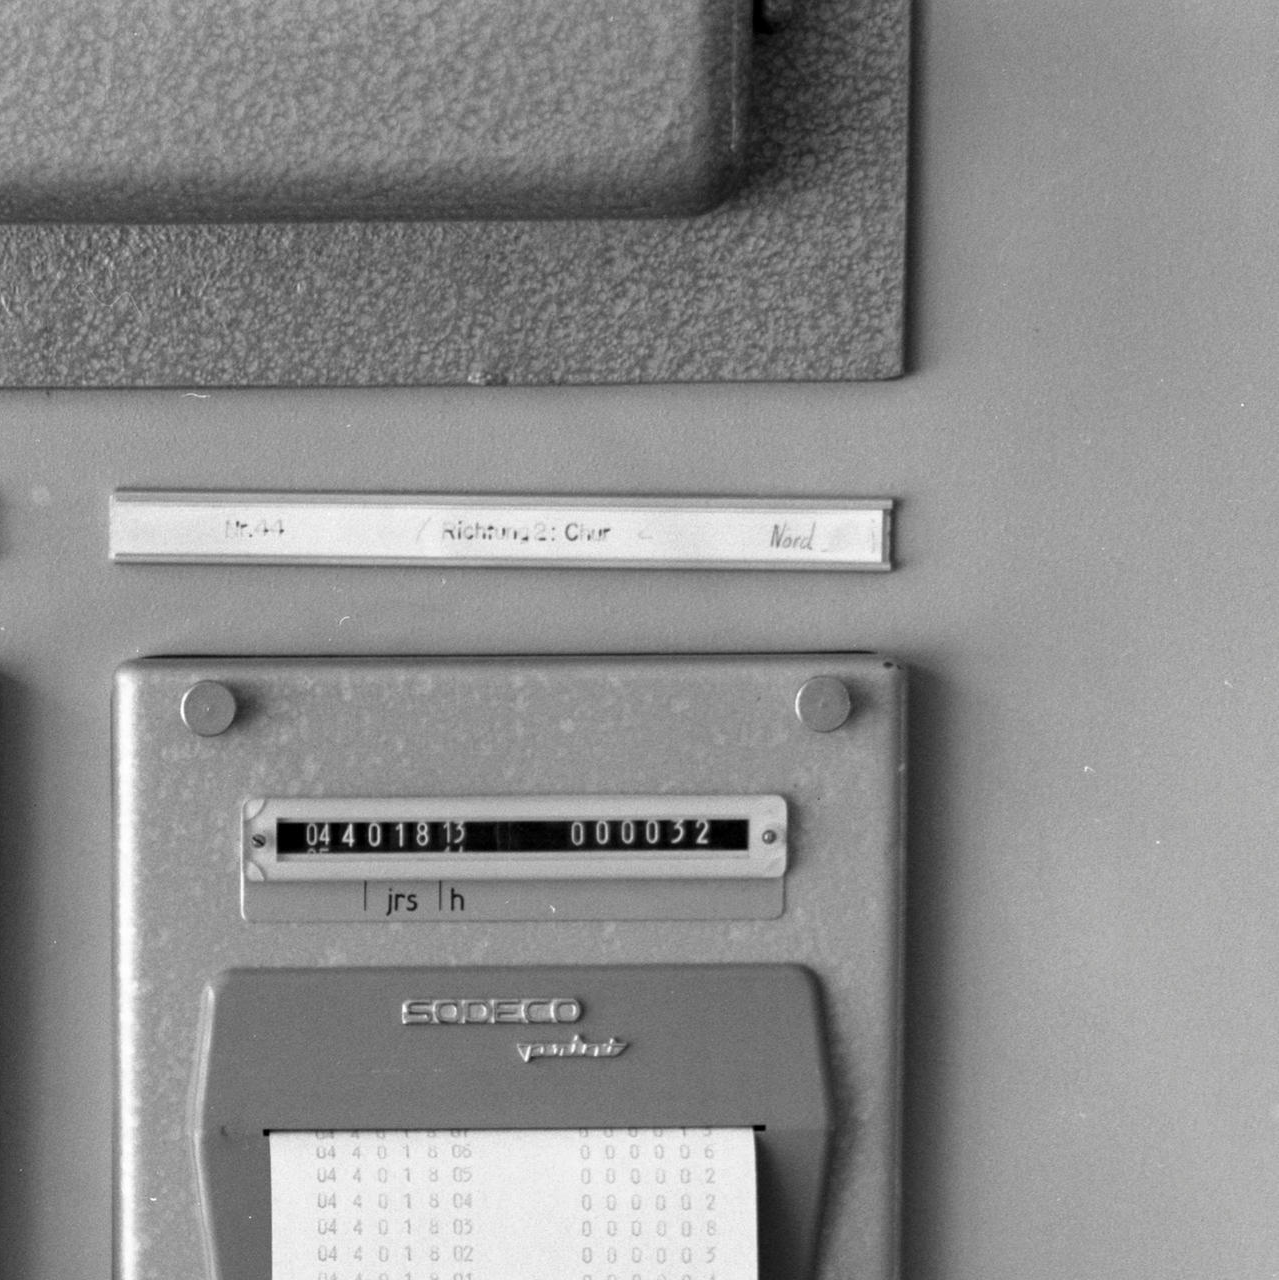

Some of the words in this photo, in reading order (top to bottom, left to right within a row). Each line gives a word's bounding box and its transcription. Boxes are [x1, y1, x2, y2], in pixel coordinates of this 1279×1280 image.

[563, 521, 612, 542] Chur
[769, 519, 817, 551] Nord
[385, 888, 419, 916] jrs
[449, 888, 465, 911] h
[401, 998, 586, 1025] SODECO
